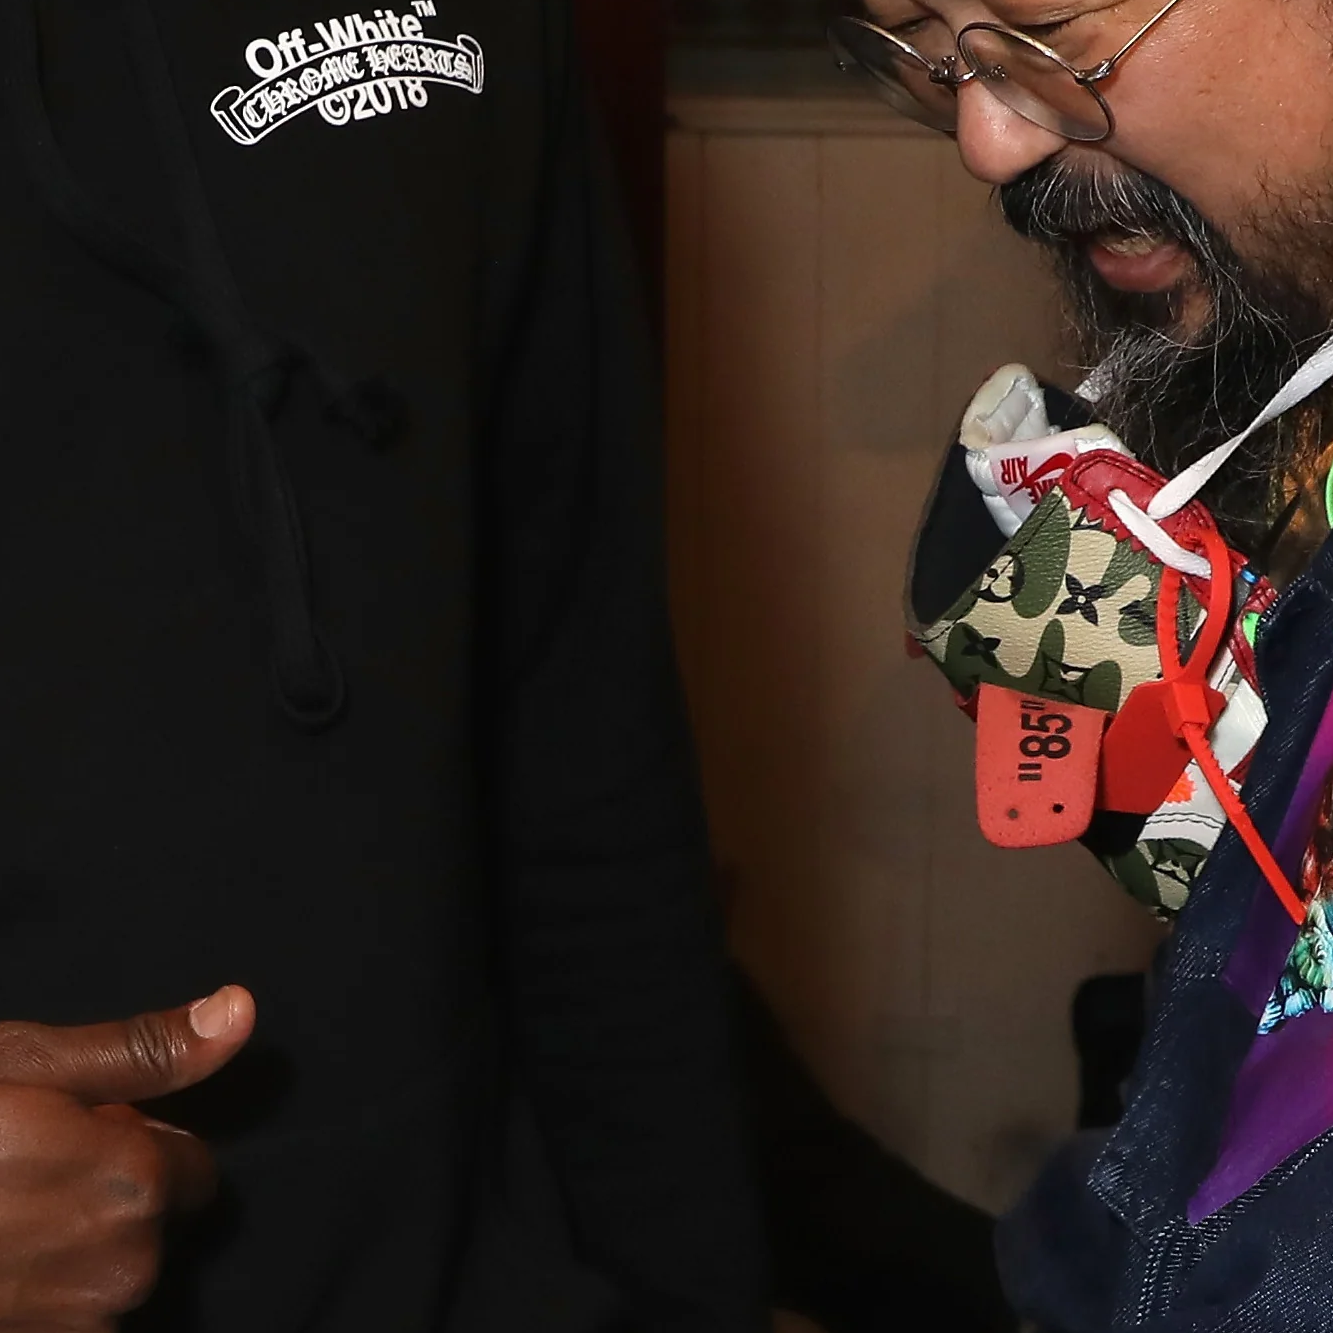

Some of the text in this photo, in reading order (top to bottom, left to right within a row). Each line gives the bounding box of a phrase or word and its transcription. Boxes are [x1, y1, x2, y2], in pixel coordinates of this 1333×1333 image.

[243, 44, 473, 129] CHROME HEARTS
[1000, 456, 1029, 486] AIR
